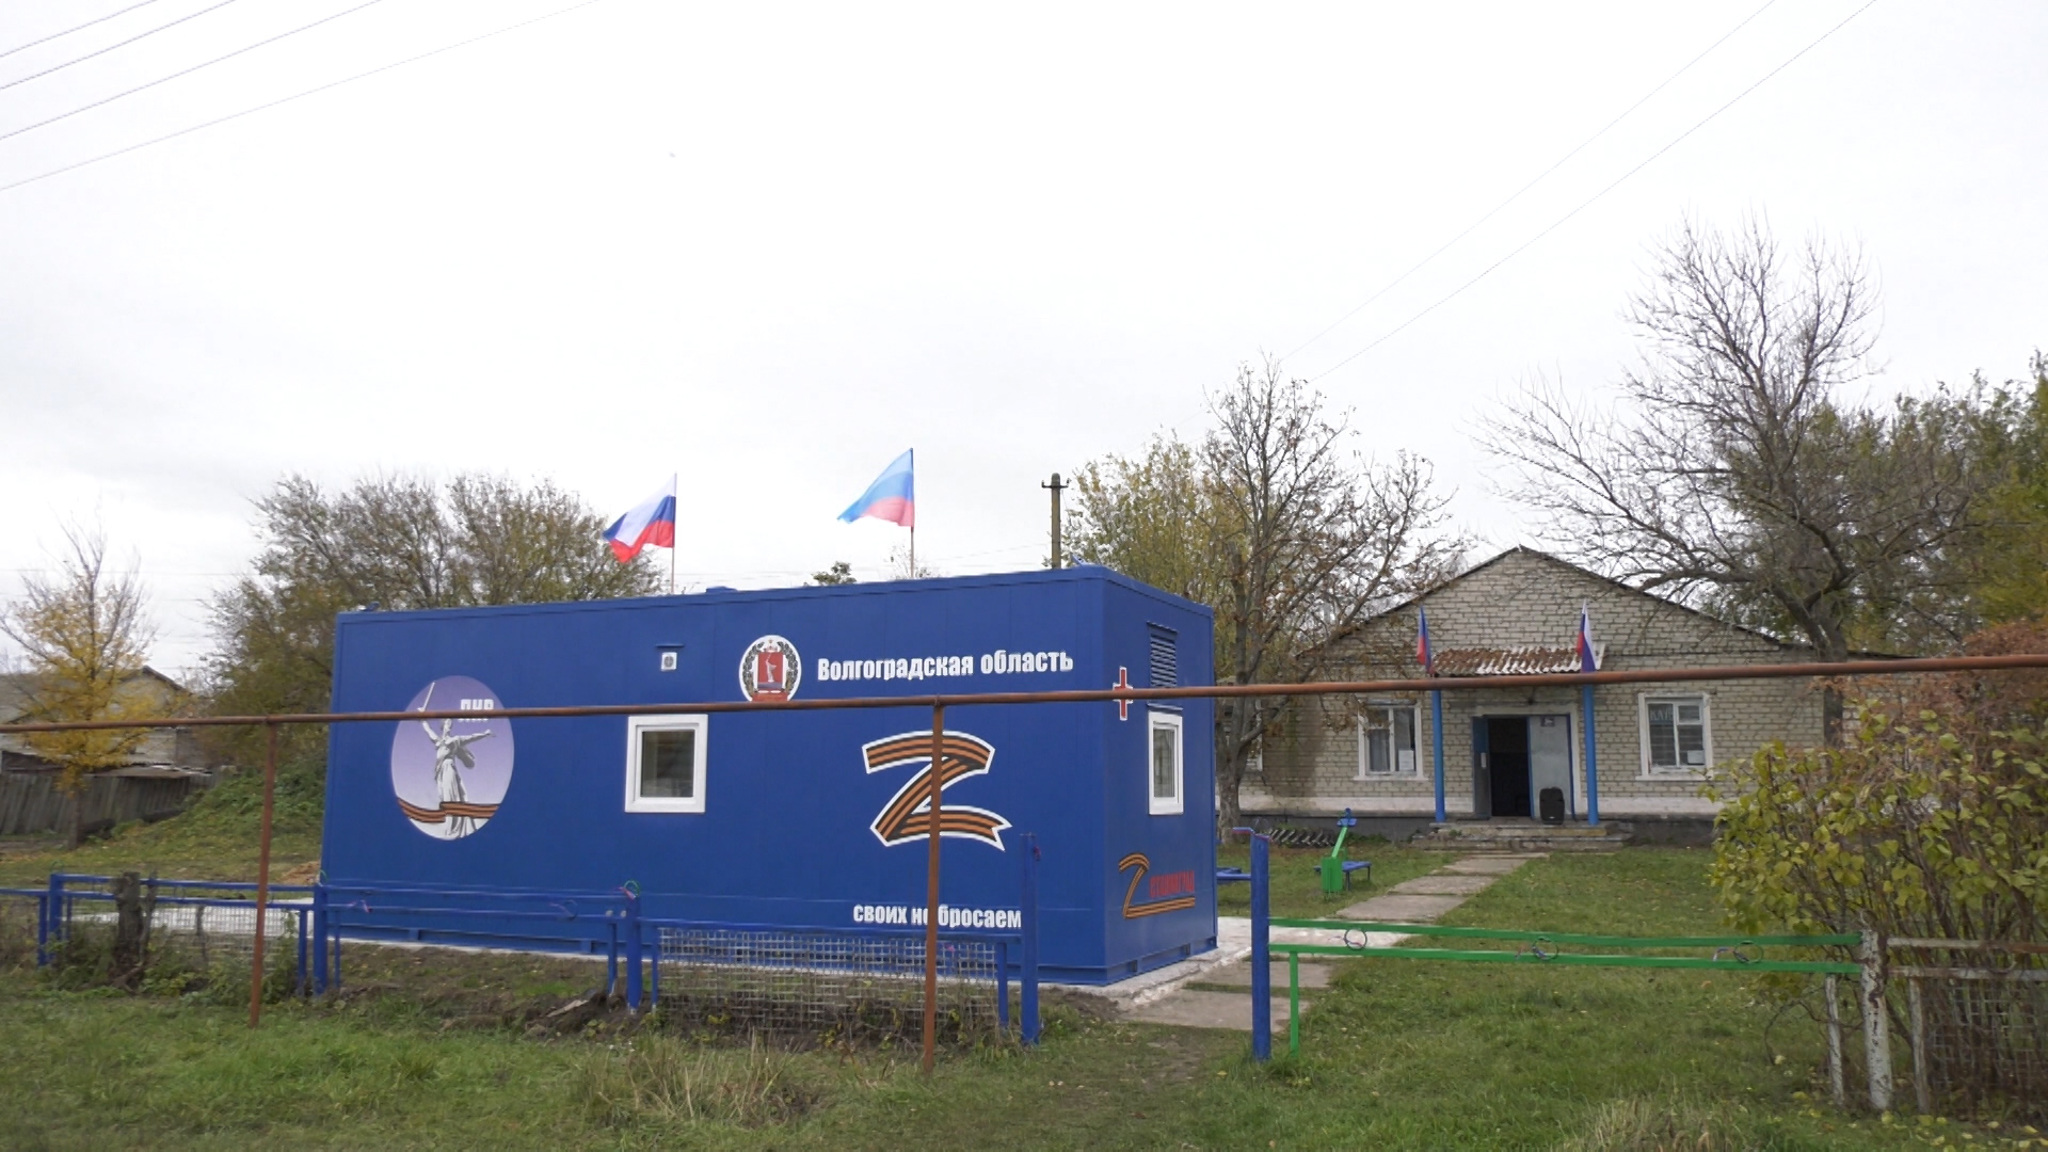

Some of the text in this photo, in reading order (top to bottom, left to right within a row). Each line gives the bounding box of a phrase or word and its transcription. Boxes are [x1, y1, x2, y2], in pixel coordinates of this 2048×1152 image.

[817, 650, 1074, 681] Волгоградская область
[853, 904, 908, 924] своих
[938, 904, 1022, 928] бросаем
